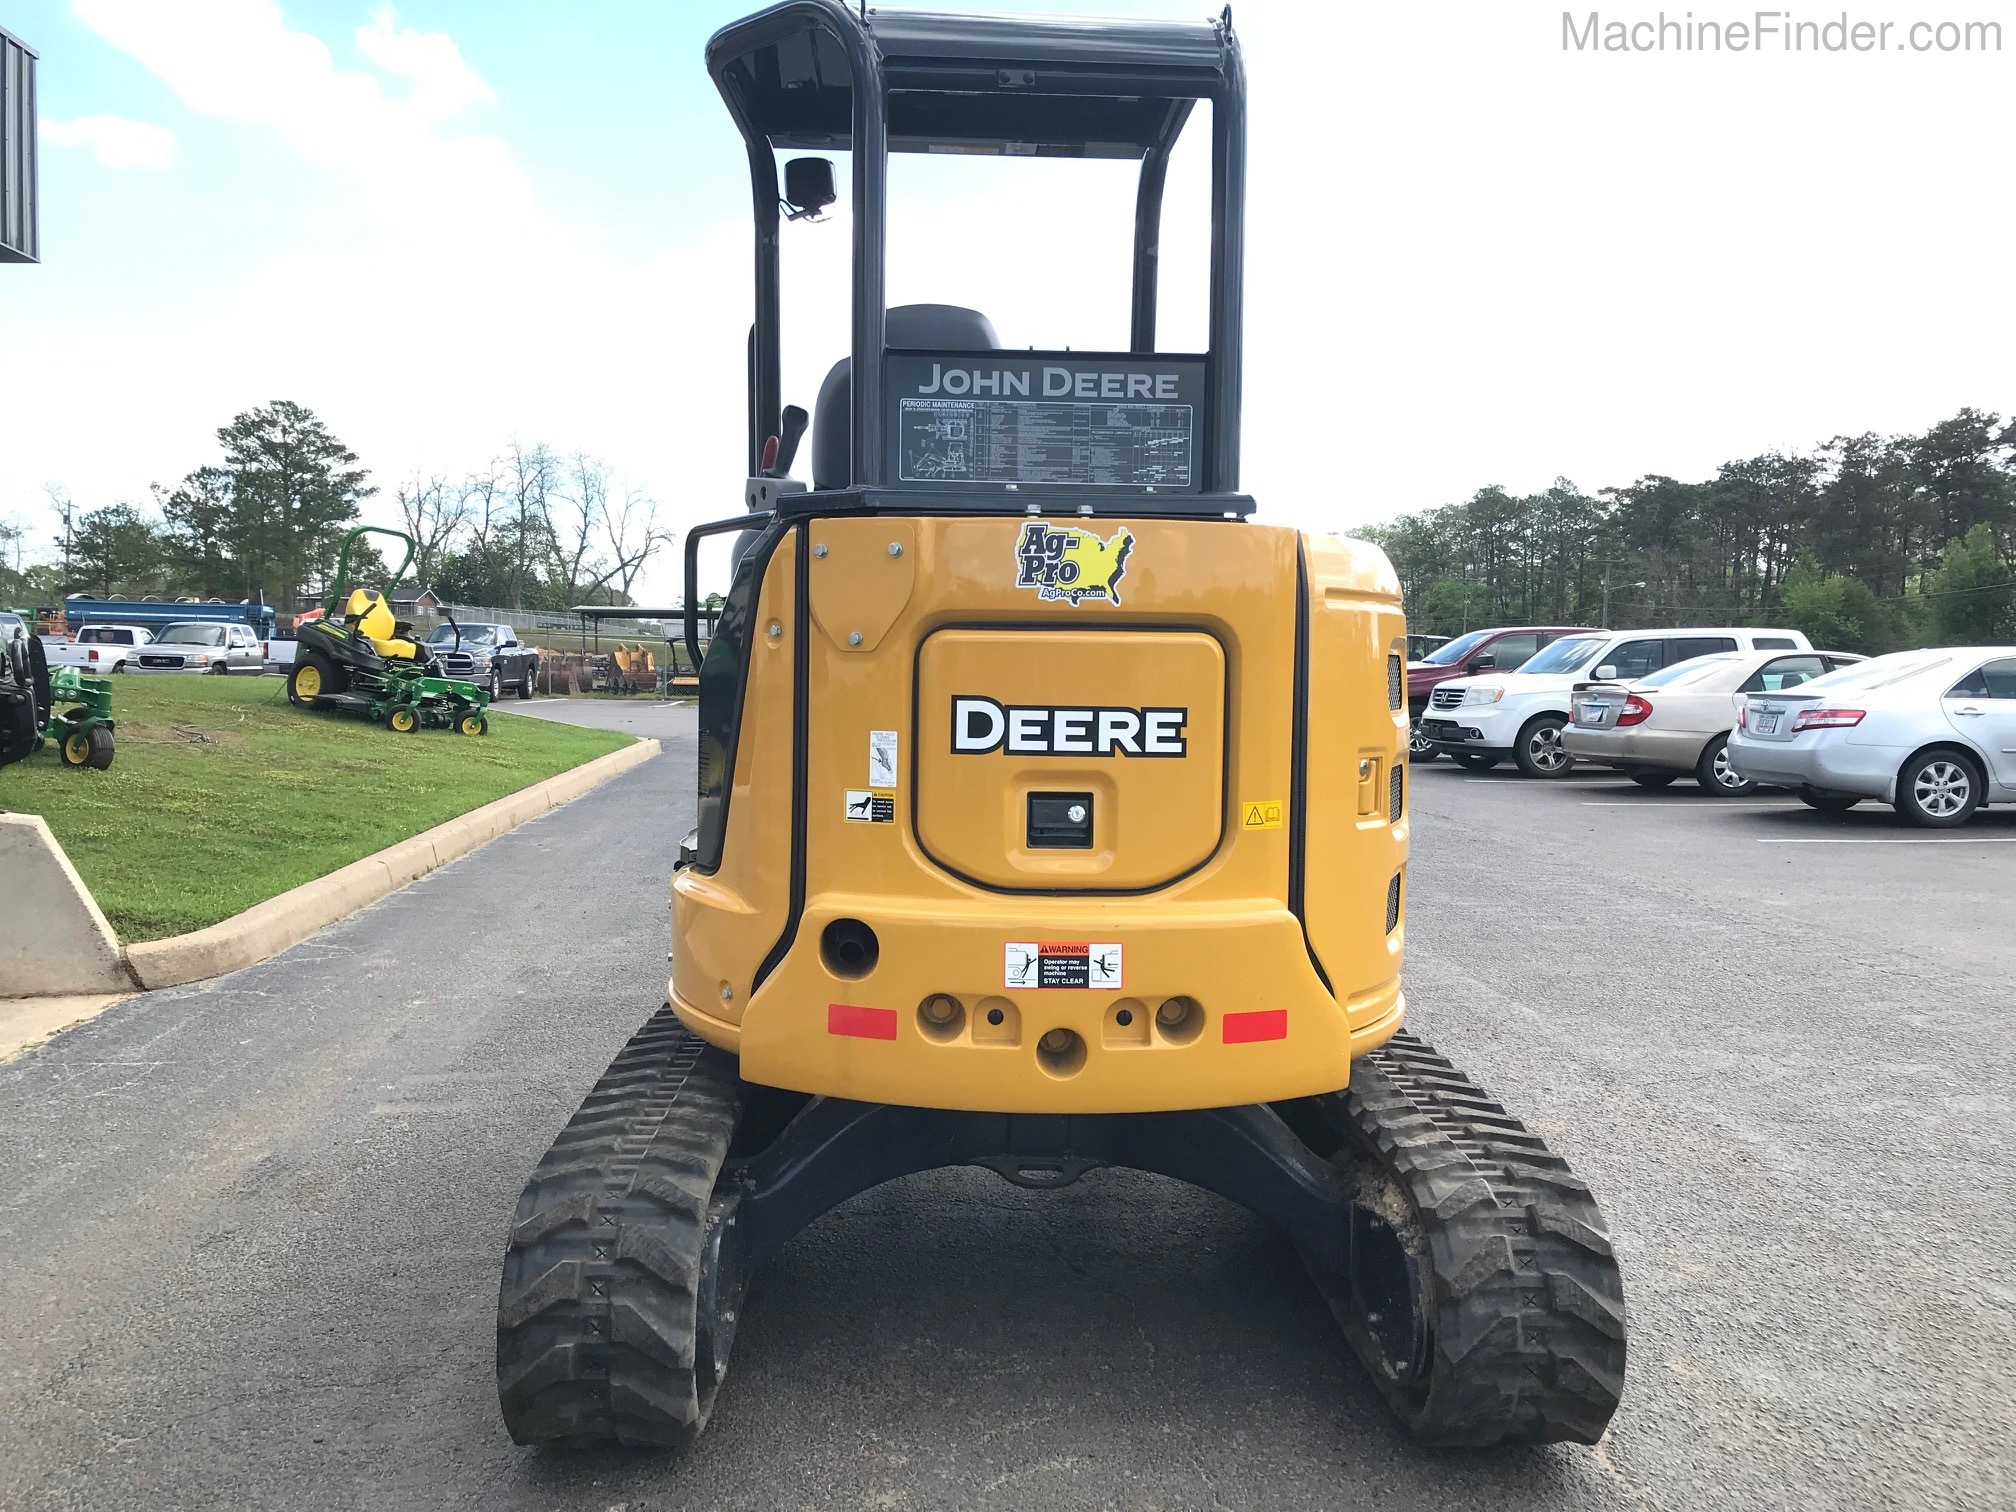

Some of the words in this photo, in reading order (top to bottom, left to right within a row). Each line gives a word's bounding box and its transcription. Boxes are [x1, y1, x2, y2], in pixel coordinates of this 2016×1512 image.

[918, 363, 1030, 396] JOHN
[1042, 366, 1179, 399] DEERE
[902, 400, 931, 408] PERIODIC
[932, 401, 975, 409] MAINTENANCE
[1019, 524, 1080, 561] Ag-
[1019, 554, 1080, 585] Pro
[1042, 588, 1106, 599] AgProCo.com
[953, 697, 1185, 756] DEERE
